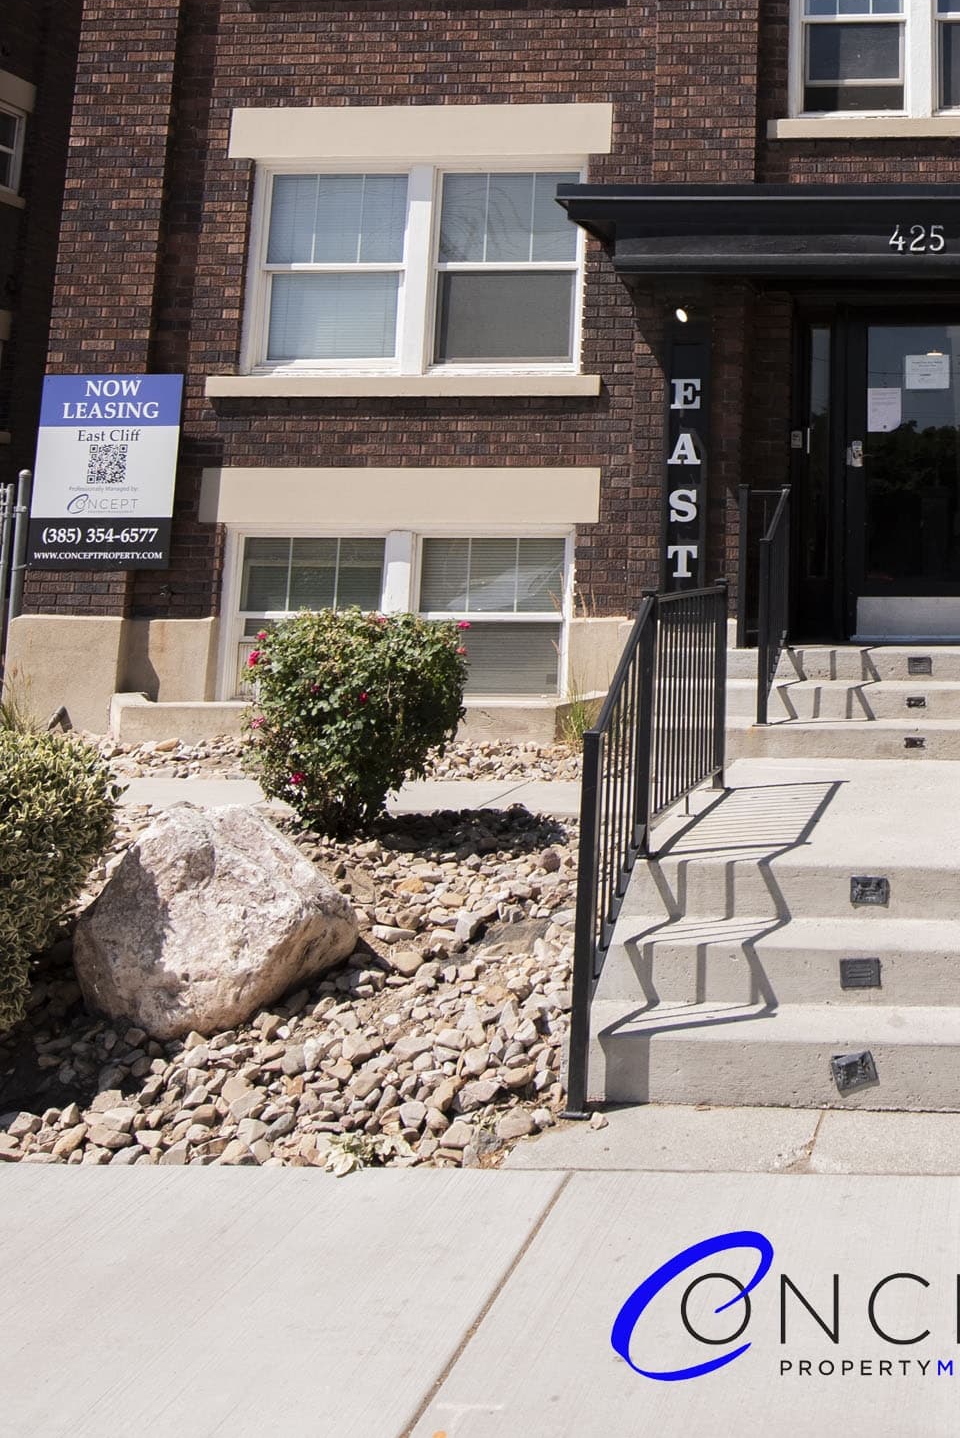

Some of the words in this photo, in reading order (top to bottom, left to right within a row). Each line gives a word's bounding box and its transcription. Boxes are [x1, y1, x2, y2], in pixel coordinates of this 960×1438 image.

[889, 224, 945, 252] 425
[86, 380, 142, 397] NOW
[62, 402, 160, 419] LEASING
[77, 430, 106, 442] East
[109, 429, 141, 442] Cliff
[667, 378, 701, 578] EAST
[67, 493, 139, 514] CONCEPT
[42, 527, 82, 544] (385)
[86, 528, 159, 543] 354-6577
[33, 551, 163, 560] WWW.CONCEPTPROPERTY.COM
